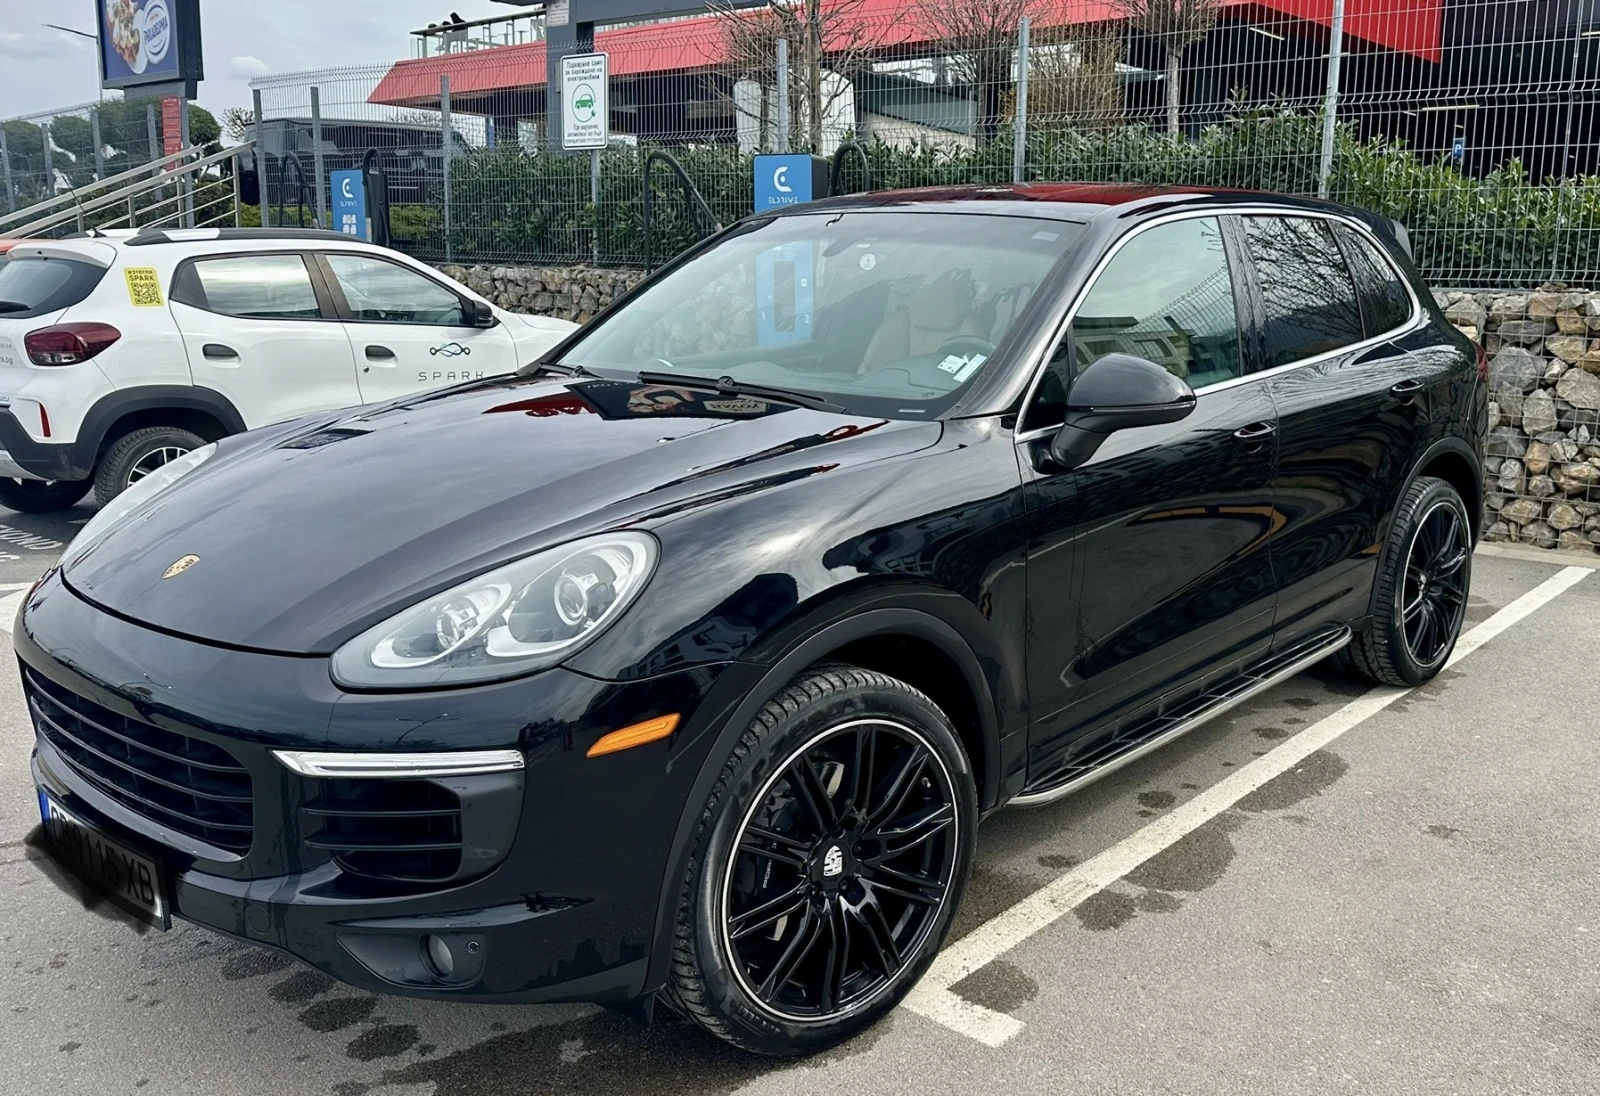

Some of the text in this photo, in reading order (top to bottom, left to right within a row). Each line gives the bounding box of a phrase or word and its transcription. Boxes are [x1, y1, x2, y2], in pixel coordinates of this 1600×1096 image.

[768, 196, 798, 204] ELDRIVE
[128, 274, 156, 282] SPARK
[417, 370, 484, 383] SPARK
